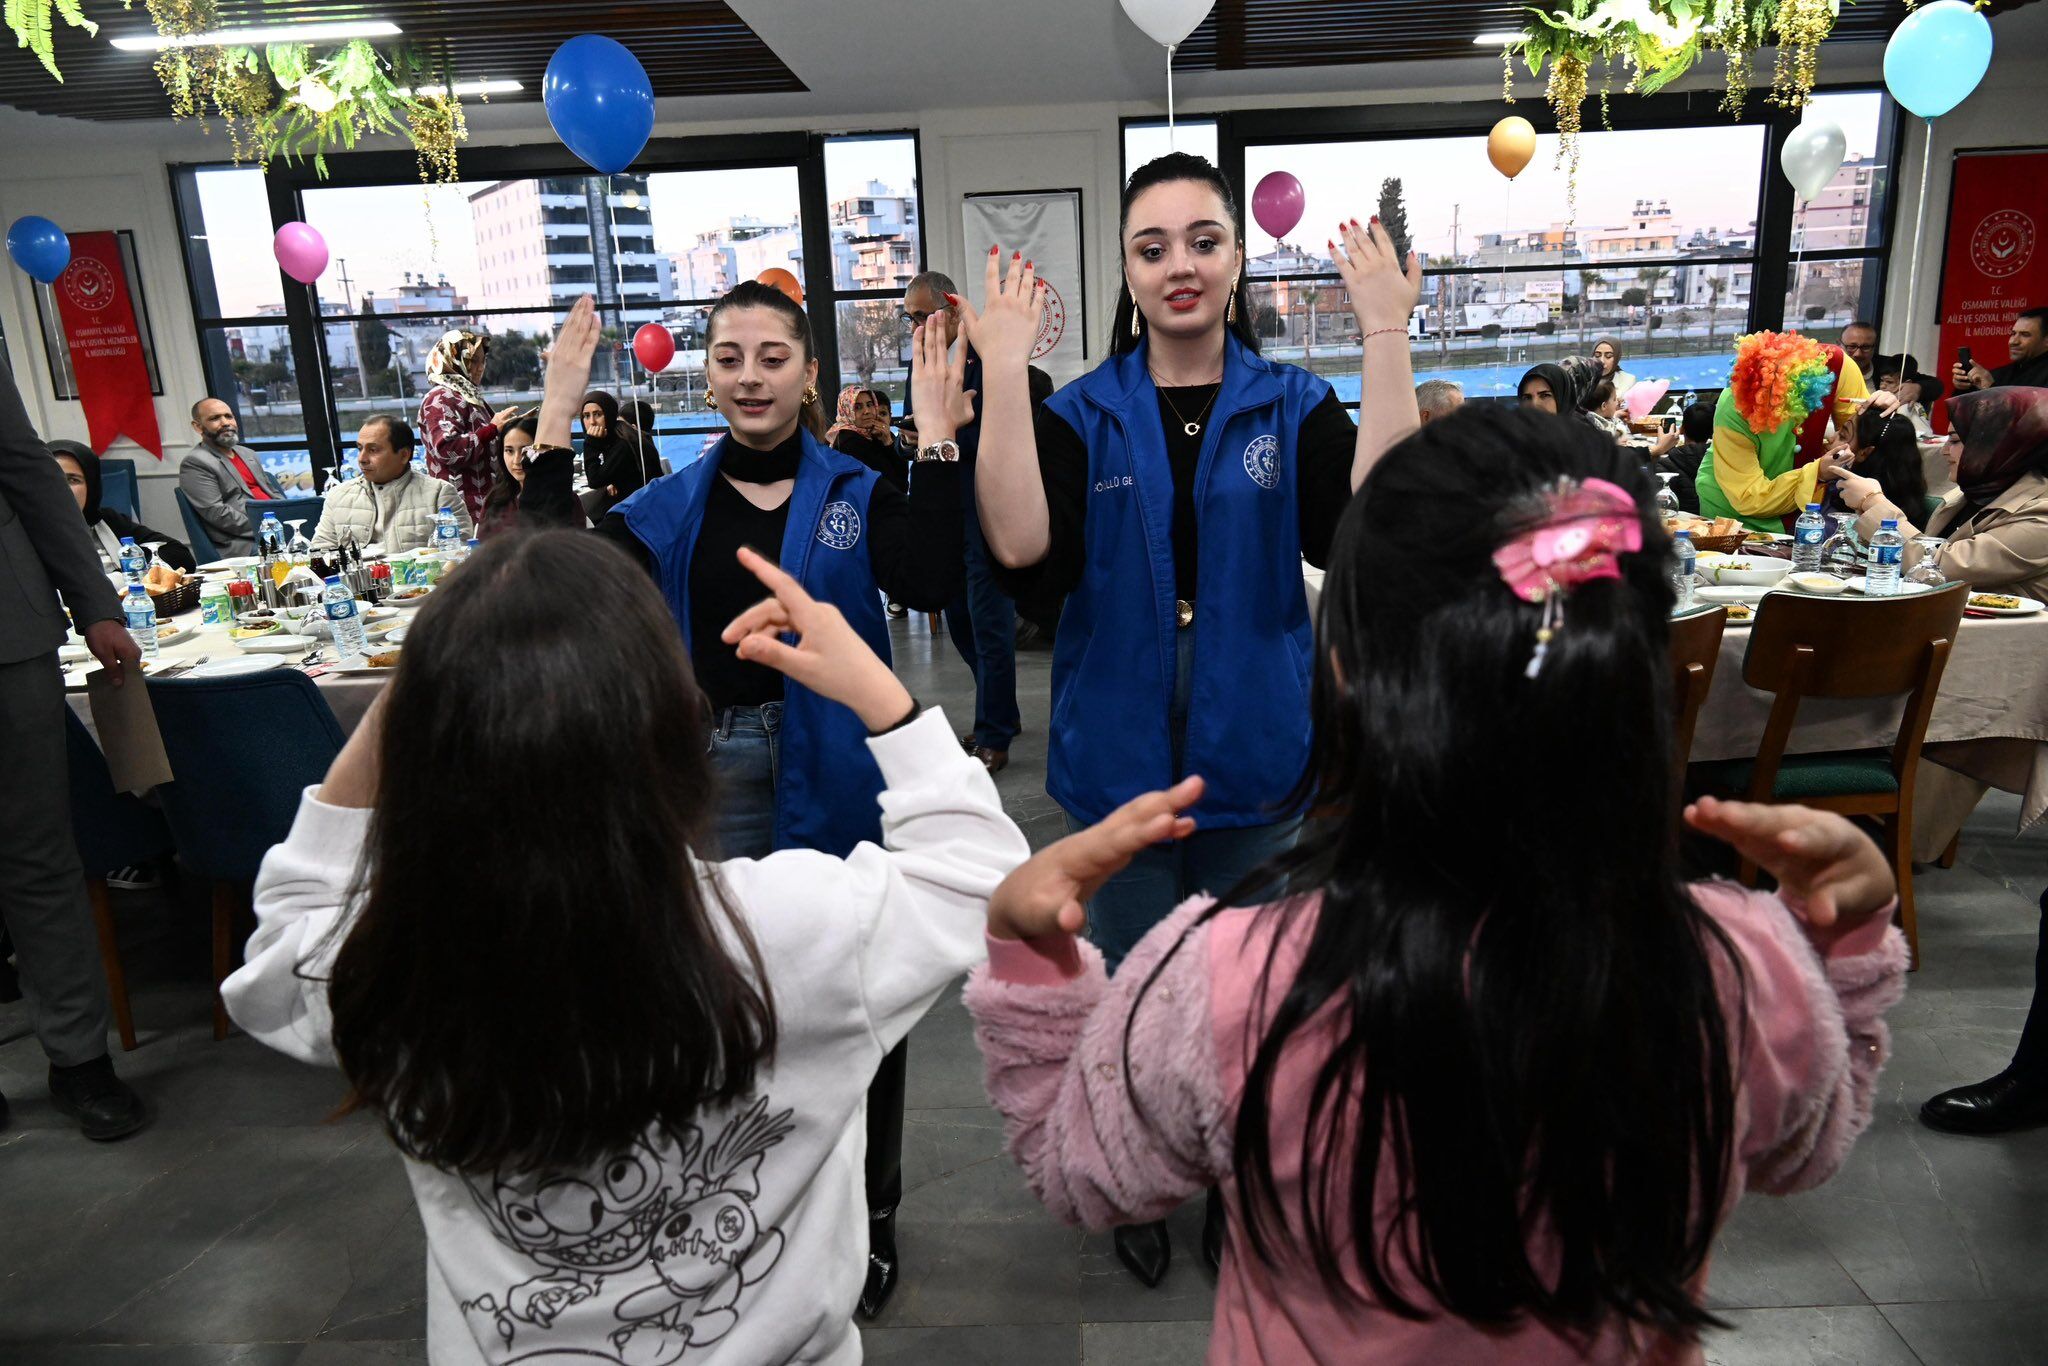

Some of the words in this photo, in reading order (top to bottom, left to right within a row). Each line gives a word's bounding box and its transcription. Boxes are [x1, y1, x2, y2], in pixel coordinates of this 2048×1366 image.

[1963, 314, 1973, 323] VE
[1974, 313, 1999, 323] SOSYAL
[1973, 325, 2014, 336] MÜDÜRLÜĞ
